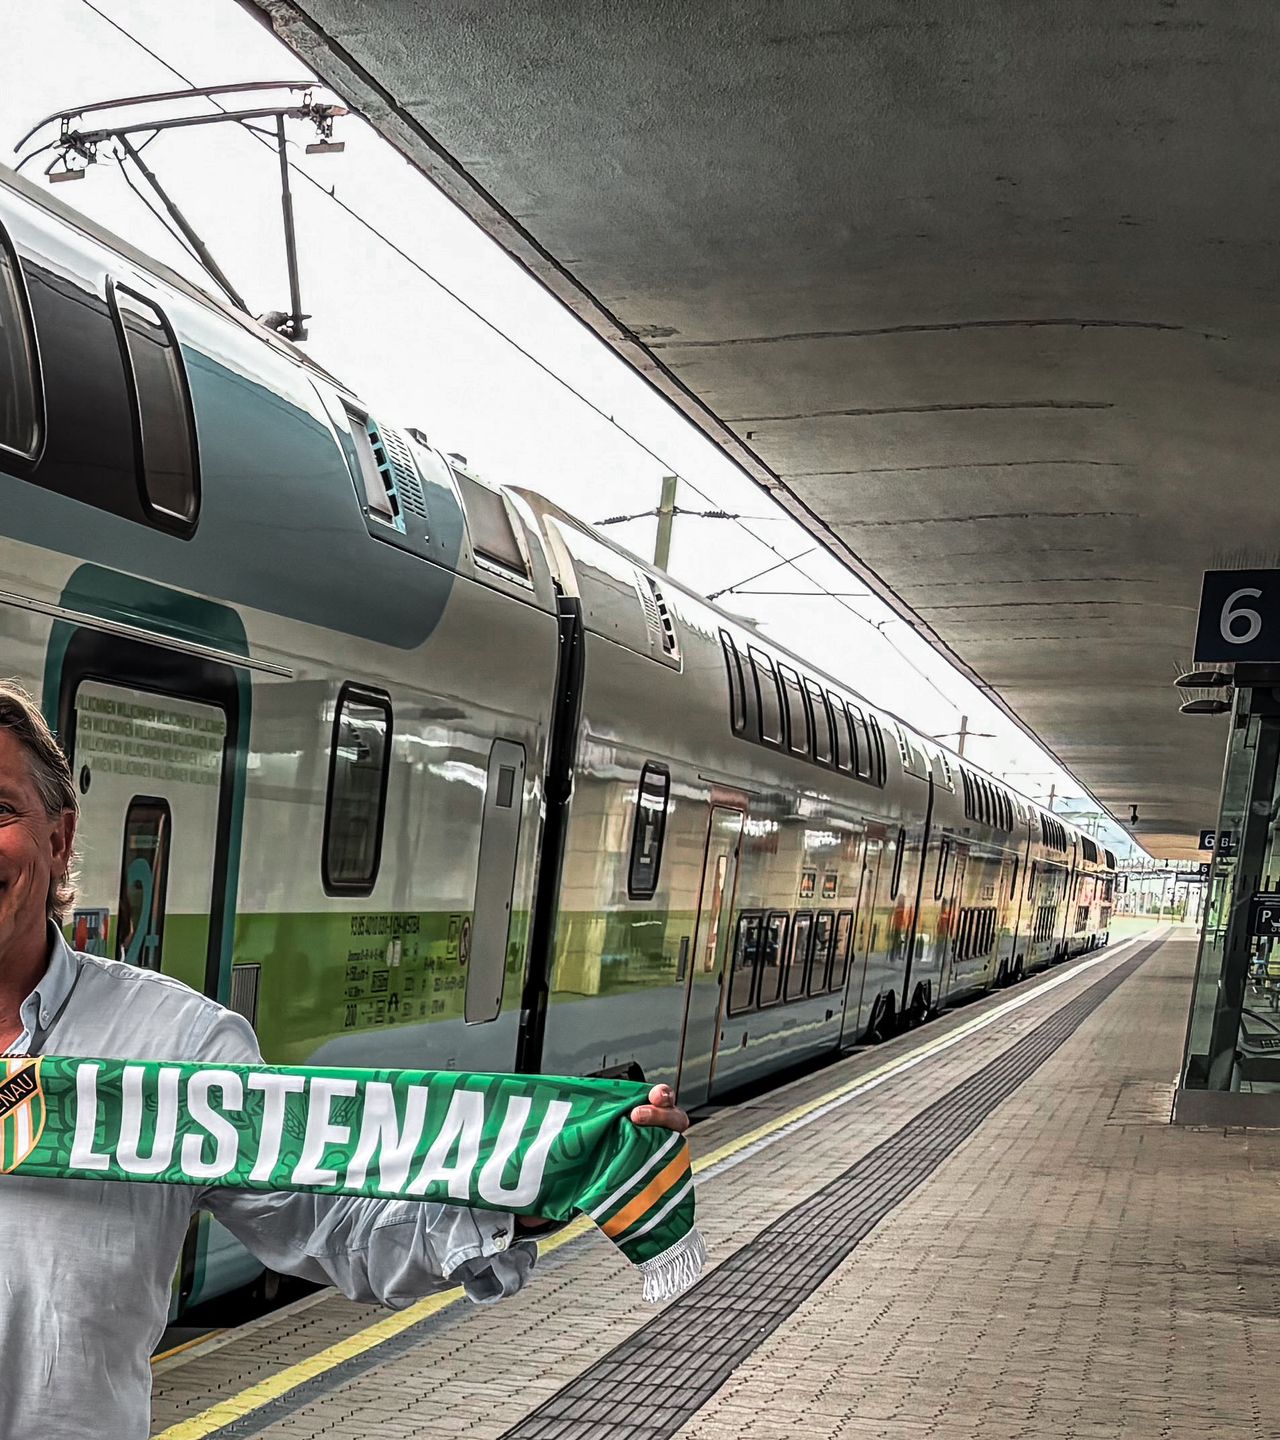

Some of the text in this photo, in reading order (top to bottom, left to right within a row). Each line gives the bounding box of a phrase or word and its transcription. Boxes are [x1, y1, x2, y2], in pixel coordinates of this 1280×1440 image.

[1220, 588, 1263, 644] 6
[1261, 910, 1272, 923] P
[68, 1063, 573, 1208] LUSTENAU
